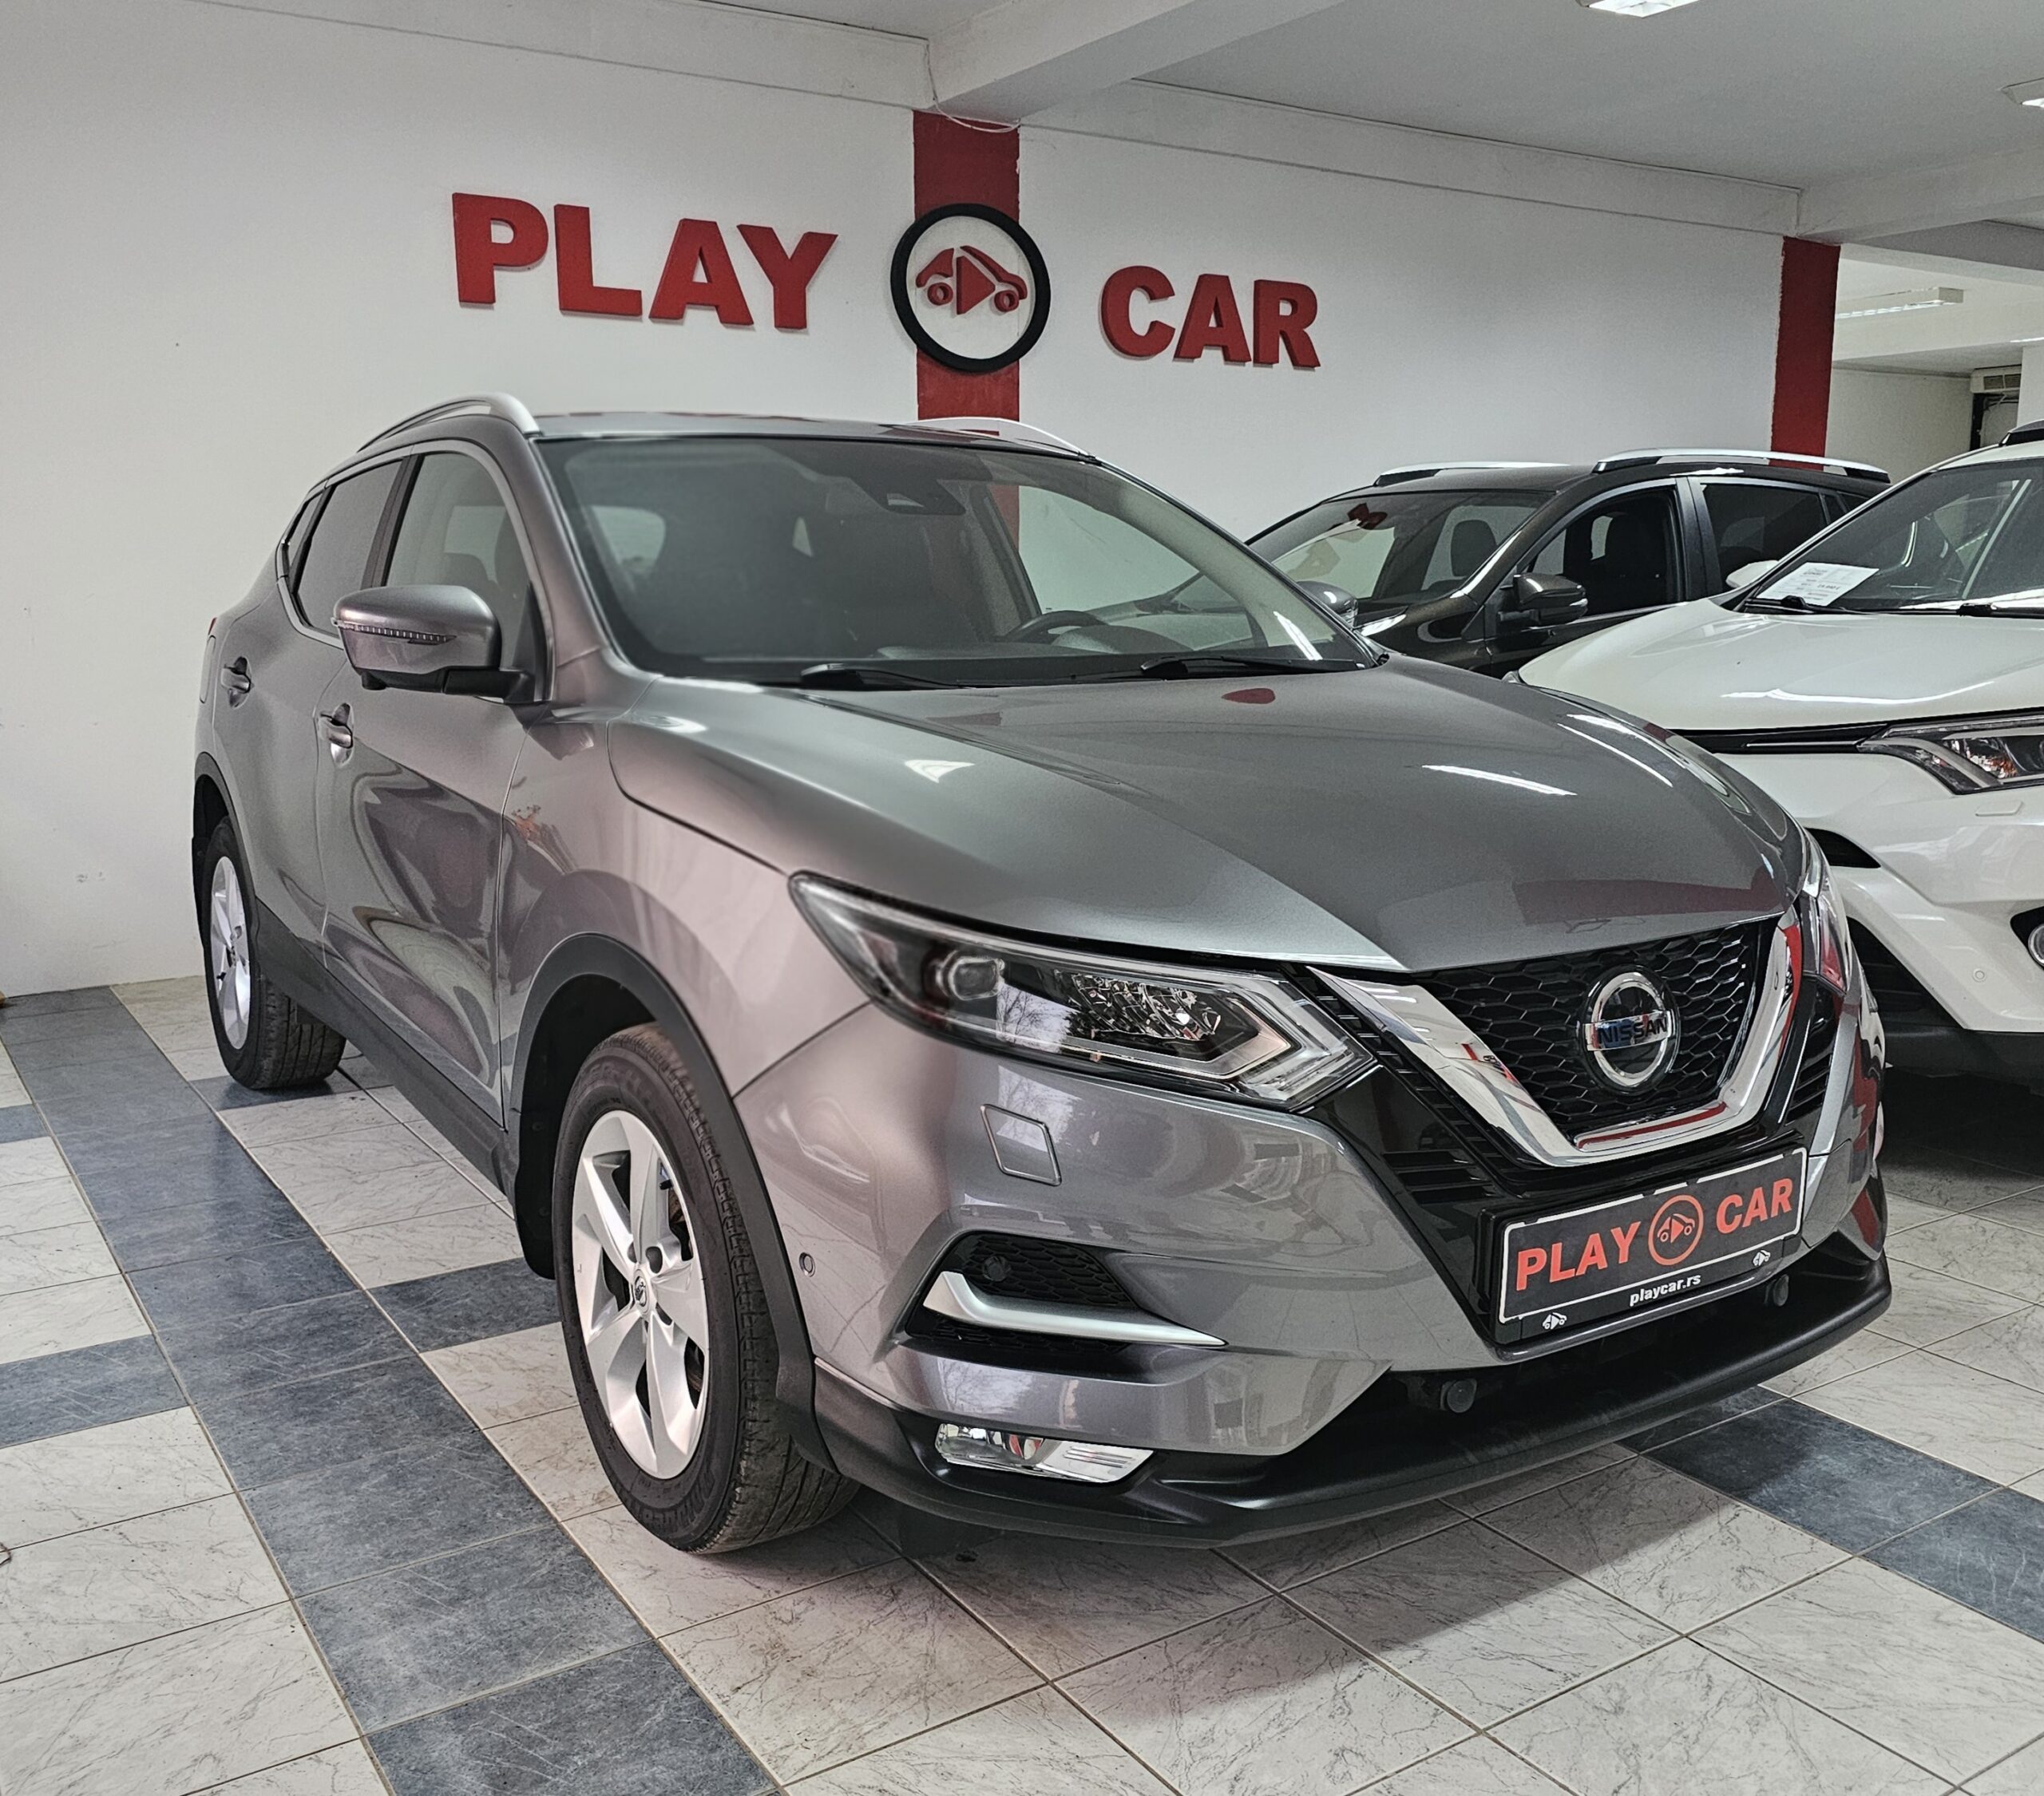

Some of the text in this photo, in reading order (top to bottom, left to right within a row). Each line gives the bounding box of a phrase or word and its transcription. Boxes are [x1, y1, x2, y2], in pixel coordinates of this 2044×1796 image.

[452, 192, 1321, 368] PLAY CAR
[1597, 1017, 1668, 1044] NISSAN
[1515, 1177, 1793, 1292] PLAY CAR
[1629, 1273, 1702, 1307] playcar.rs
